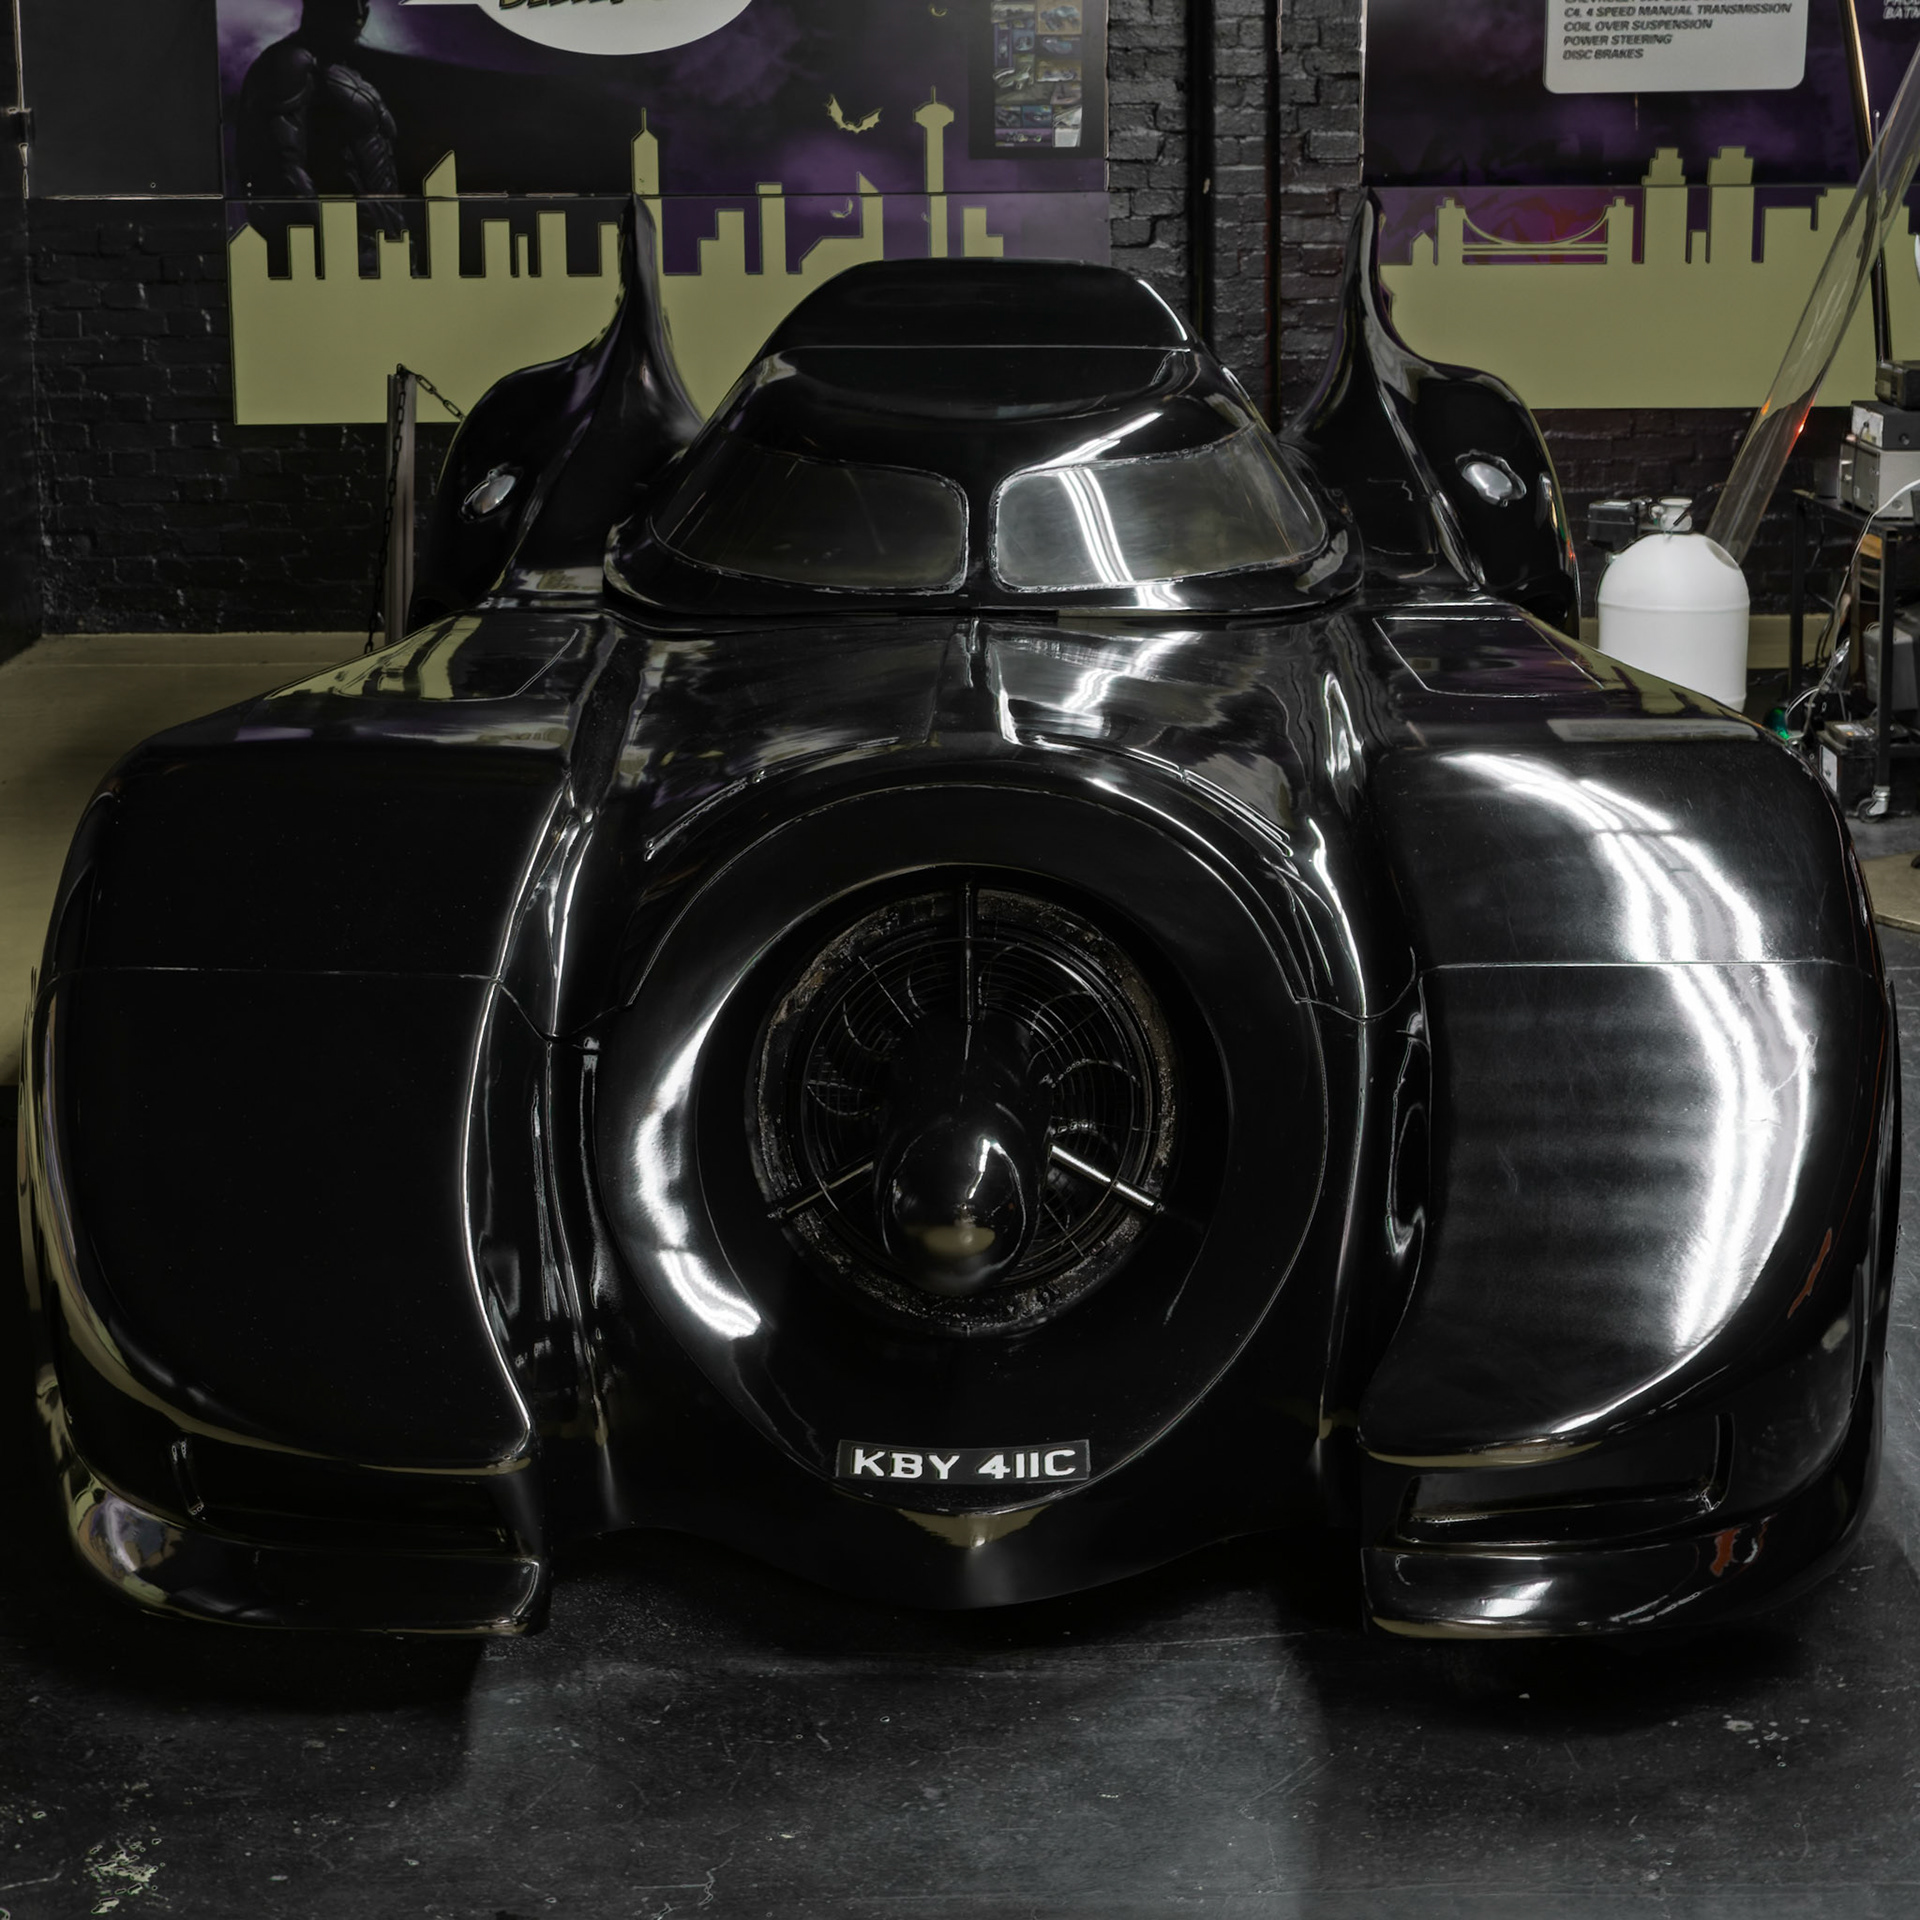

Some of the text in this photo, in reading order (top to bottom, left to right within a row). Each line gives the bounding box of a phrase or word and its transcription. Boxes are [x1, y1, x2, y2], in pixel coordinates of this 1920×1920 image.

[1586, 7, 1594, 17] 4
[1596, 6, 1636, 17] SPEED
[1638, 5, 1693, 16] MANUAL
[1697, 3, 1792, 15] TRANSMISSION
[1563, 19, 1713, 32] COIL OVER SUSPENSION
[1563, 33, 1673, 46] POWER STEERING
[1562, 48, 1644, 60] DISC BRAKES
[853, 1448, 960, 1480] KBY
